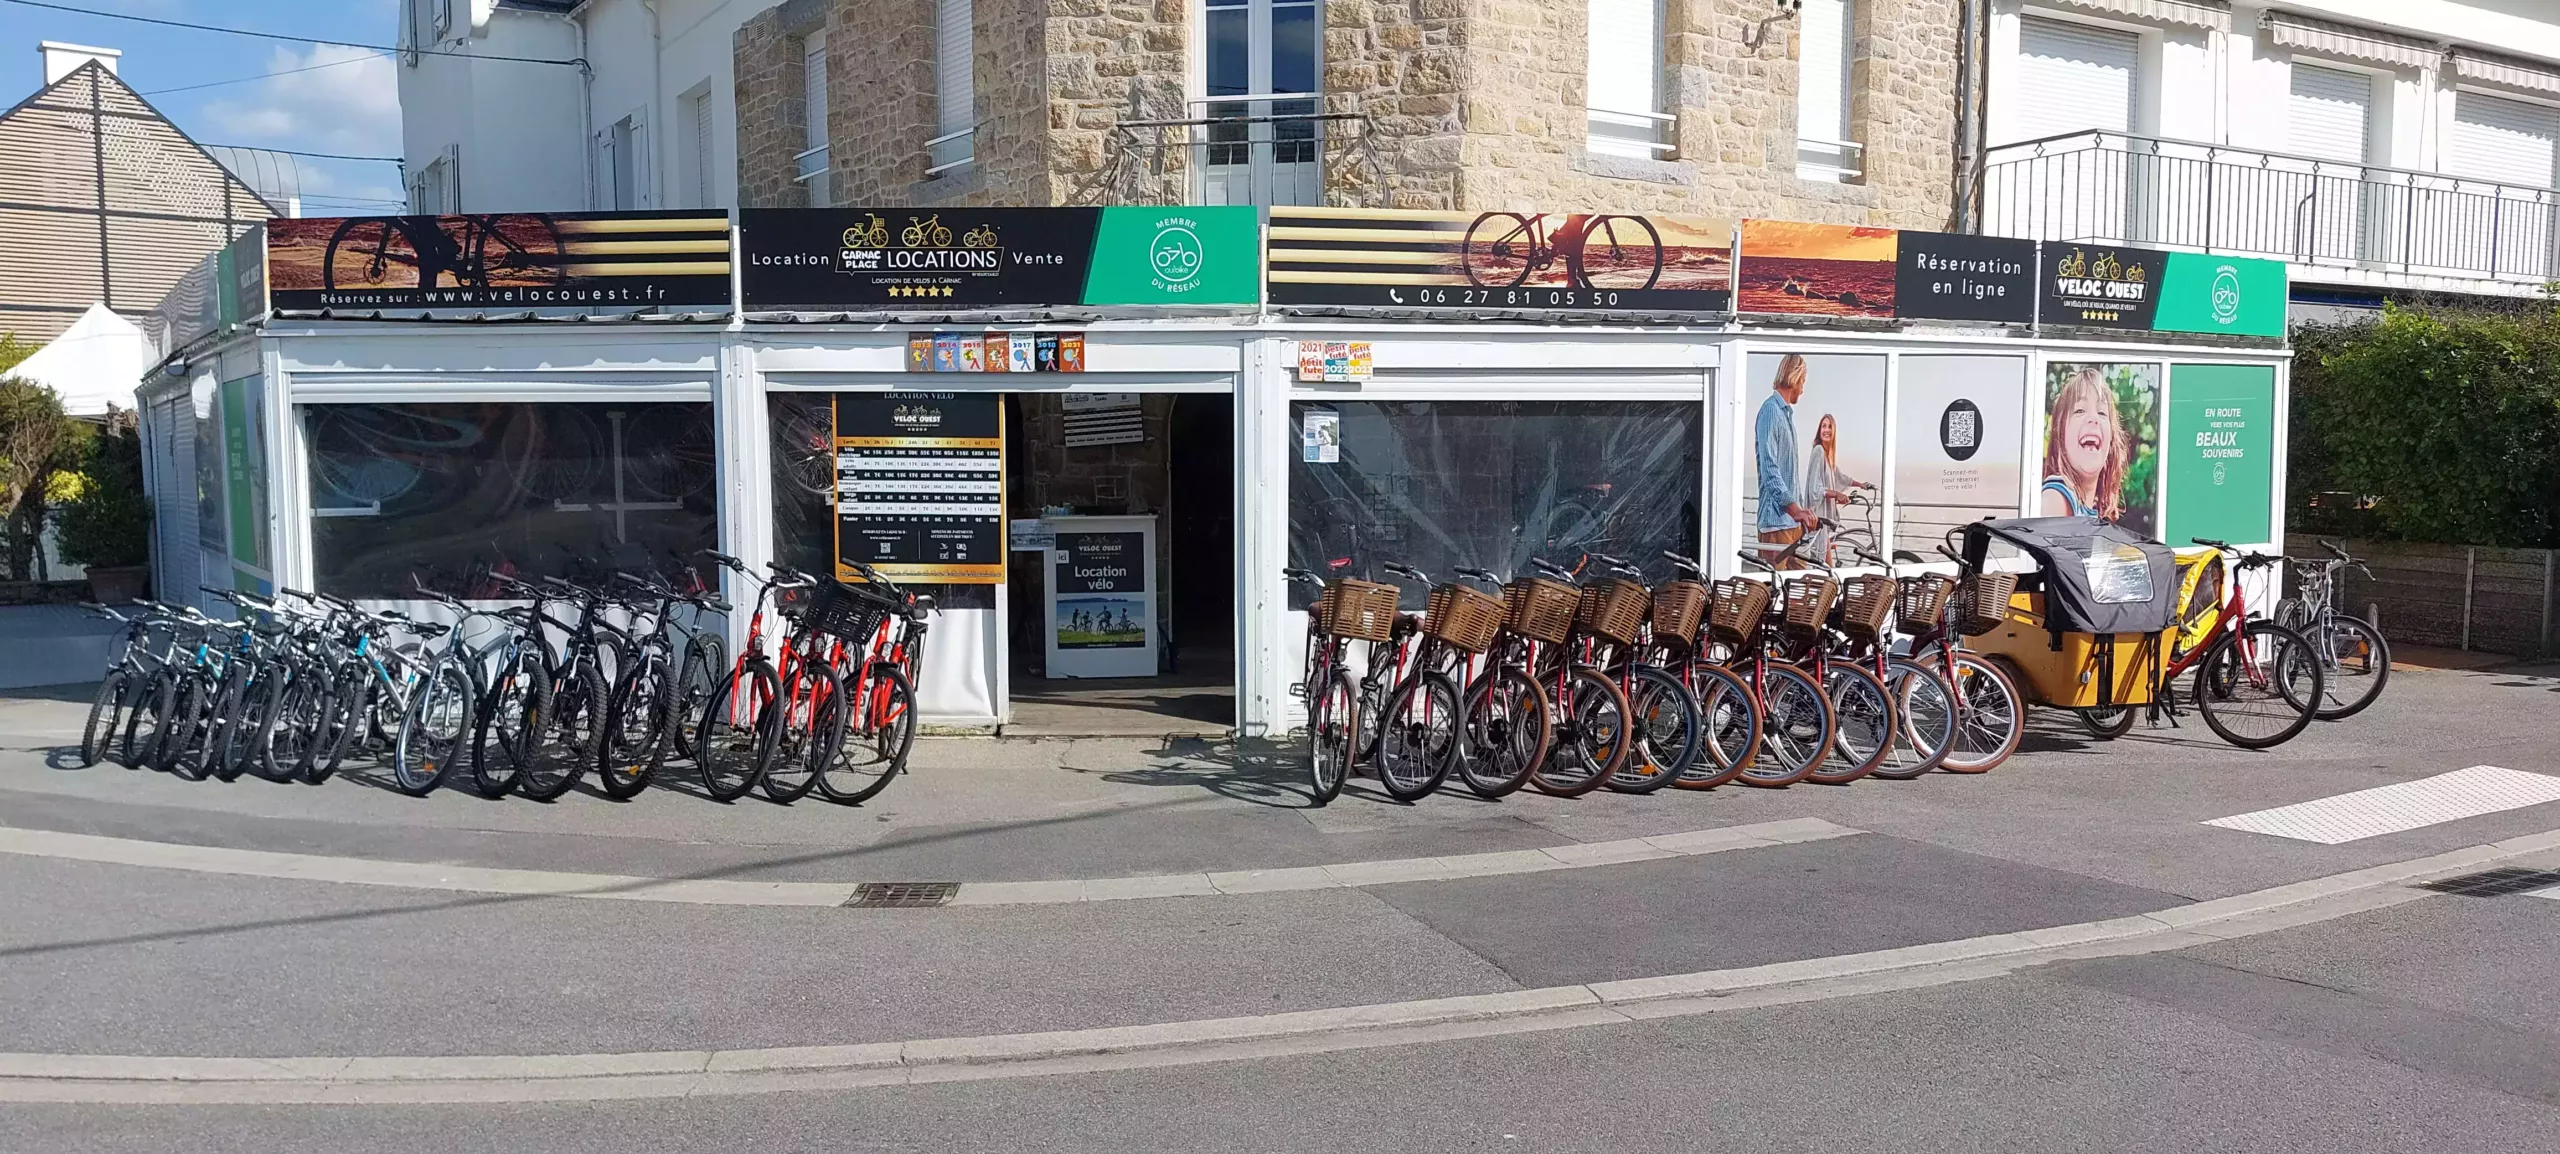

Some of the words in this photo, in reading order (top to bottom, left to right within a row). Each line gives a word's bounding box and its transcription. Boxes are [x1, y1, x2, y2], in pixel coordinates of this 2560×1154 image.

[1155, 217, 1197, 229] MEMBRE
[752, 252, 829, 265] Location
[841, 250, 882, 260] CARNAC
[887, 250, 997, 268] LOCATIONS
[1012, 251, 1064, 265] Vente
[845, 260, 878, 269] PLAGE
[1917, 253, 2021, 275] Réservation
[1151, 278, 1165, 289] DU
[1167, 278, 1201, 292] RÉSEAU
[1932, 282, 1952, 294] en
[1962, 278, 2005, 300] ligne
[320, 293, 381, 304] Réservez
[388, 295, 409, 303] sur
[425, 285, 666, 302] www.velocouest.fr
[1420, 289, 1446, 303] 06
[1463, 290, 1489, 303] 27
[1507, 290, 1531, 304] 81
[1550, 291, 1575, 305] 05
[1593, 292, 1618, 306] 50
[1301, 342, 1322, 352] 2021
[1325, 344, 1346, 354] petit
[1349, 345, 1370, 355] petit
[1300, 357, 1323, 367] petit
[1325, 365, 1348, 373] 2022
[2205, 408, 2216, 417] EN
[2217, 408, 2242, 417] ROUTE
[2195, 431, 2237, 447] BEAUX
[2202, 448, 2244, 459] SOUVENIRS
[1058, 553, 1067, 561] ici
[1074, 565, 1127, 578] Location
[1088, 577, 1114, 590] vélo
